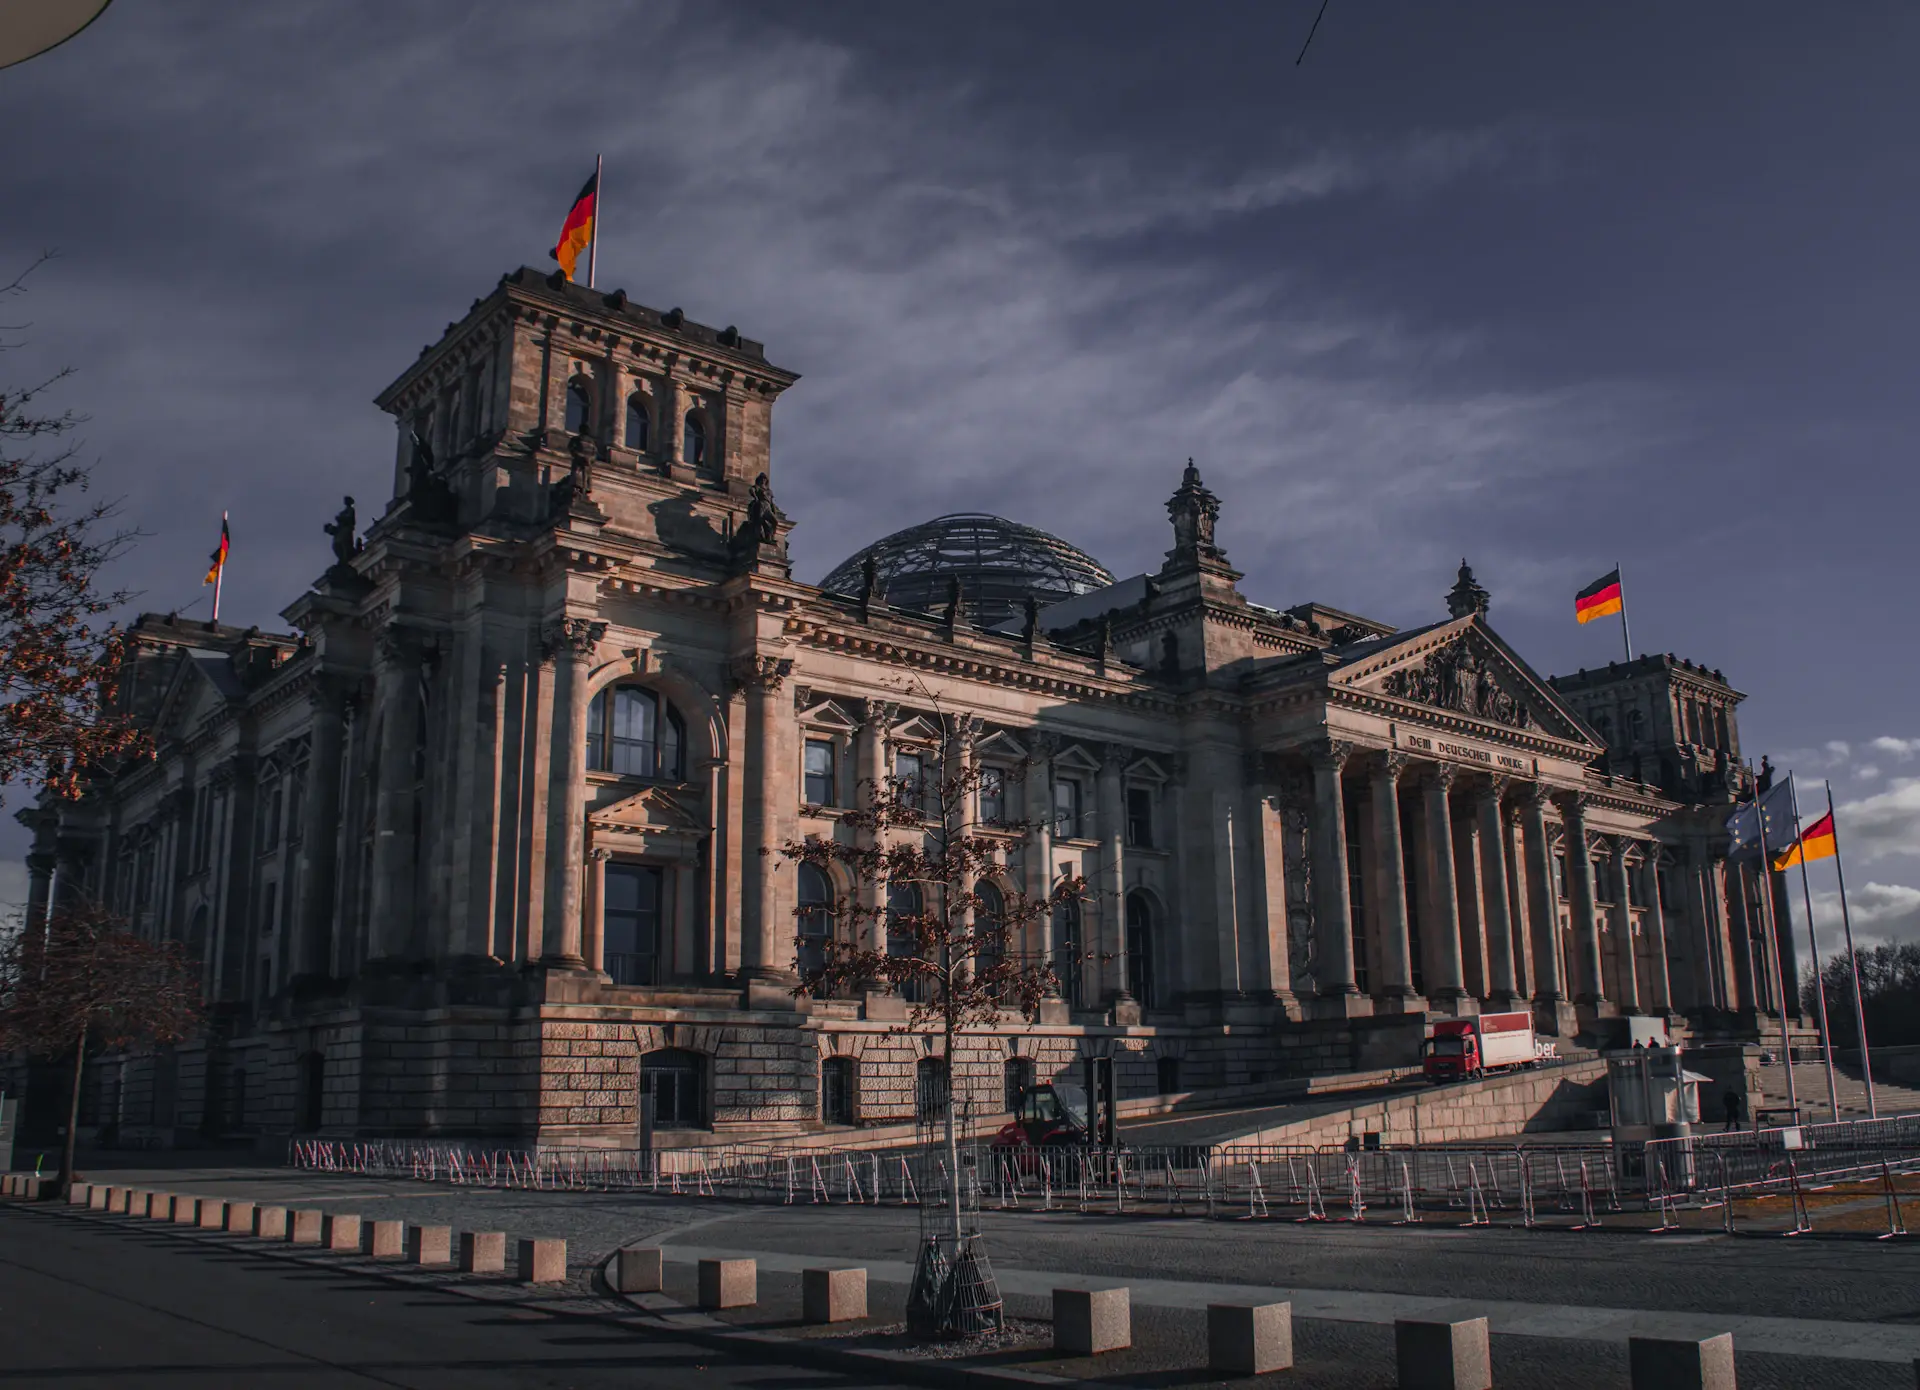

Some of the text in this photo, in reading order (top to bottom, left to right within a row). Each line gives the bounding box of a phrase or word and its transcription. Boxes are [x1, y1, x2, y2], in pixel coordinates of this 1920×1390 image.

[1408, 735, 1524, 770] DEM DEUTSCHEN VOLKE
